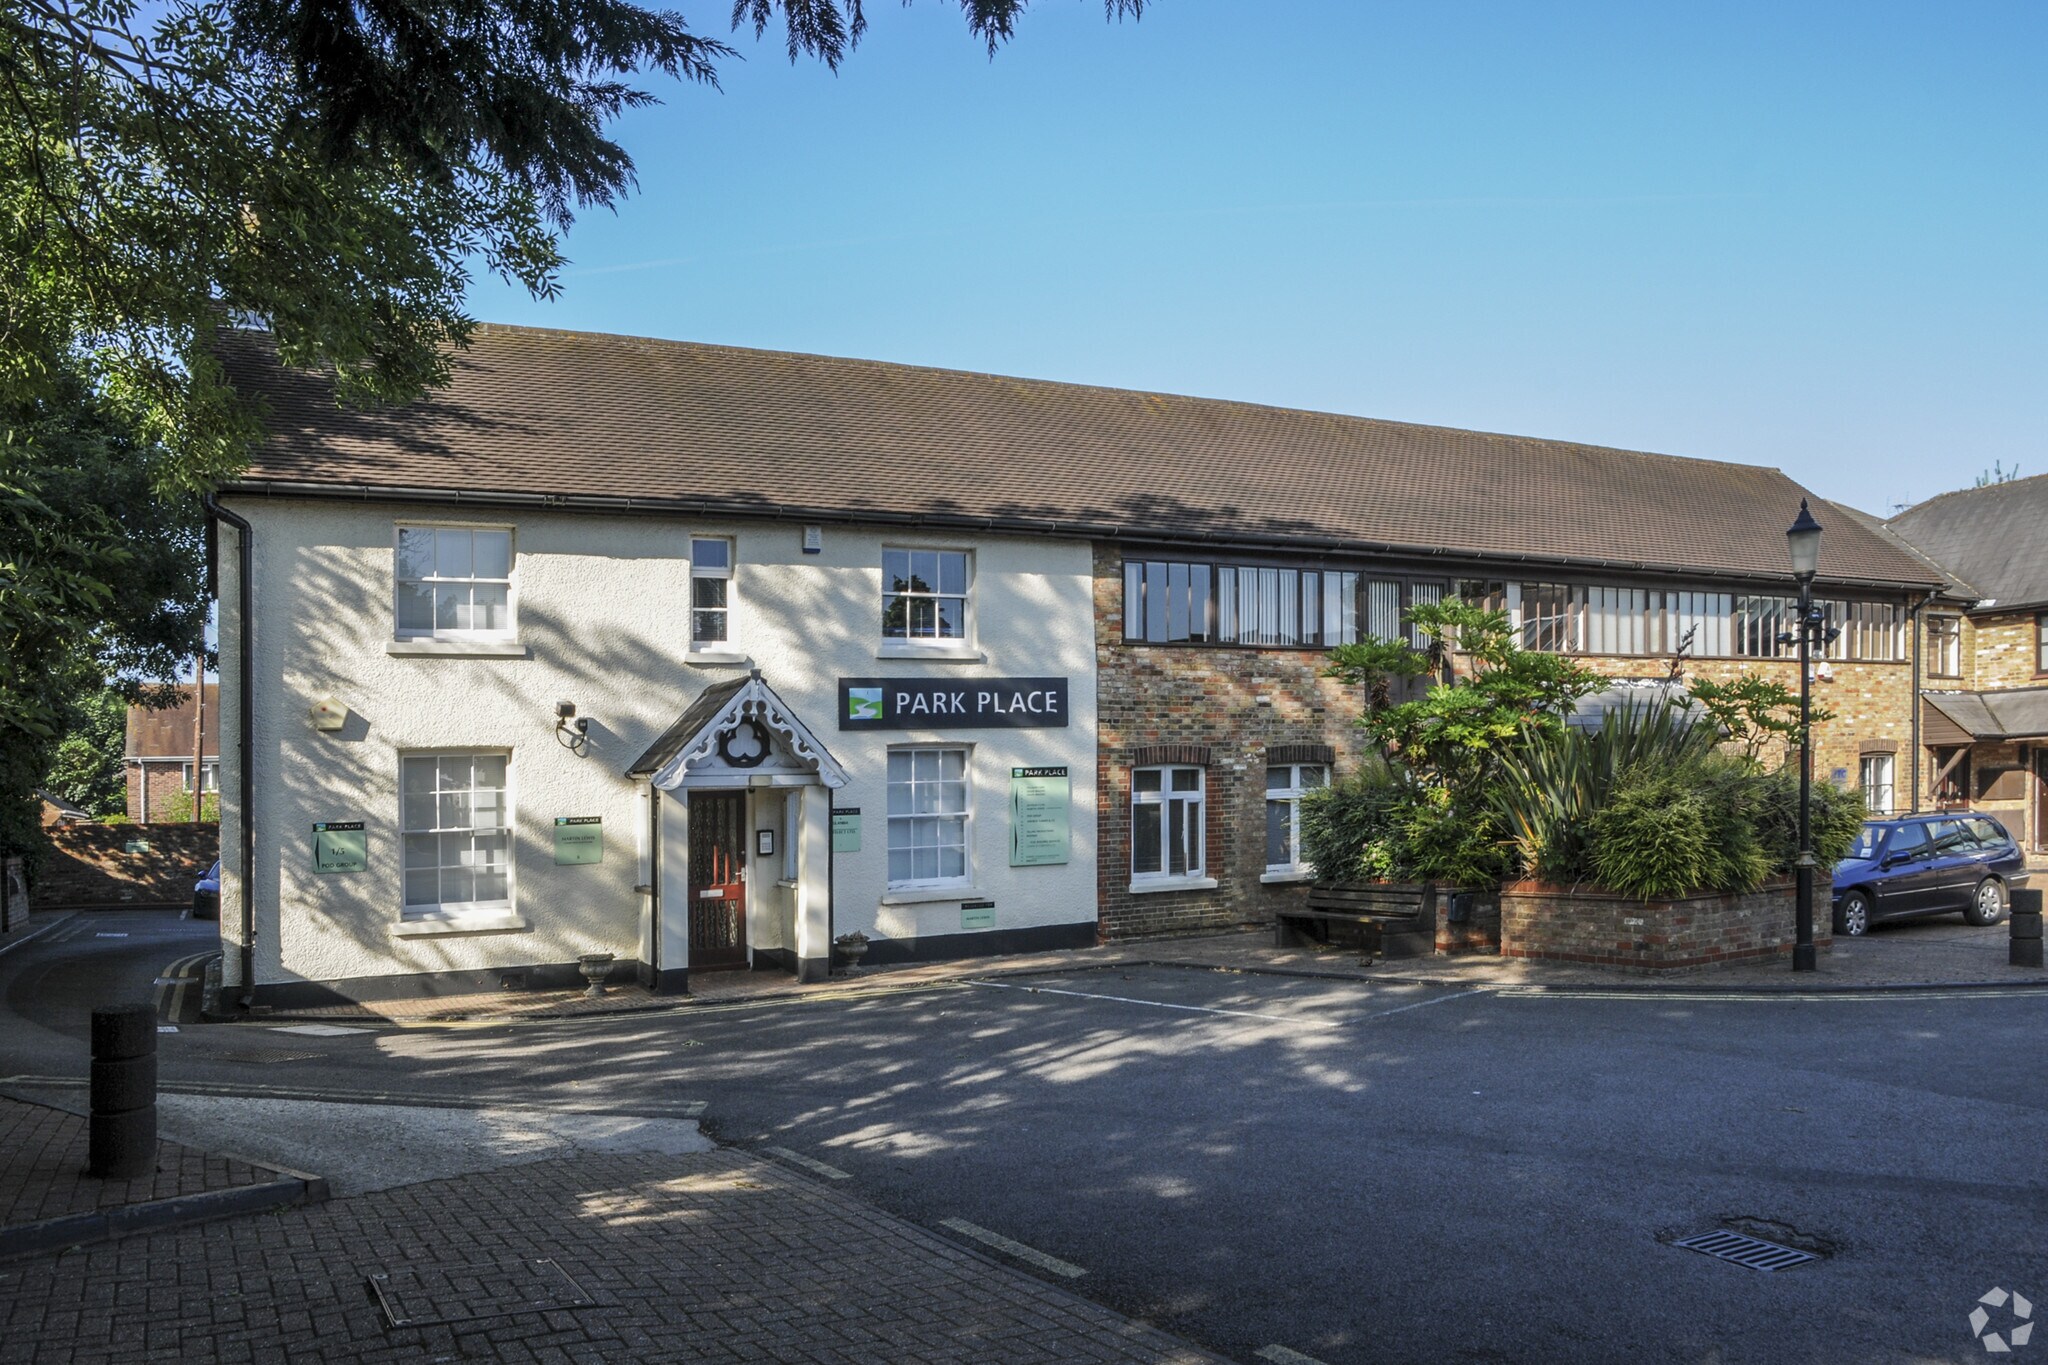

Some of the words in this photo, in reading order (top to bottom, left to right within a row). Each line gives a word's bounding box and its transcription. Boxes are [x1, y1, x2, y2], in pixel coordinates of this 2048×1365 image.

[896, 692, 966, 714] PARK
[977, 690, 1058, 713] PLACE
[1044, 768, 1066, 776] PLACE
[331, 847, 345, 856] 1/5
